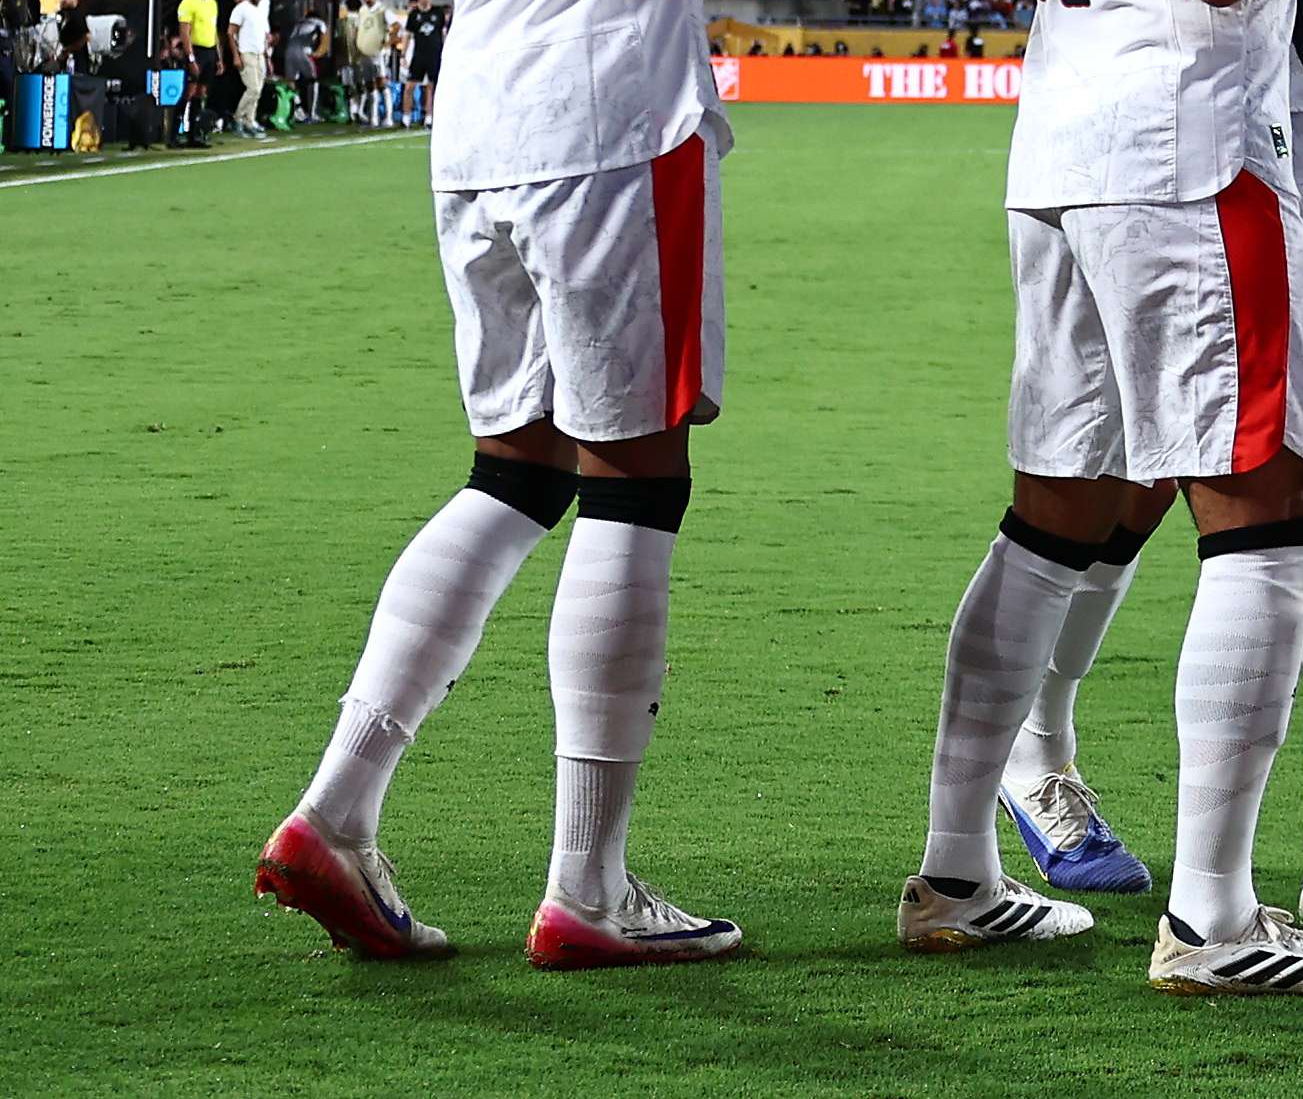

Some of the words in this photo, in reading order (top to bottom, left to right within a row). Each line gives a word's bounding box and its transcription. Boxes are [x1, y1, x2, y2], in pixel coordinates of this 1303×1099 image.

[863, 63, 948, 98] THE
[963, 64, 1022, 99] HO
[42, 75, 56, 147] POWERADE
